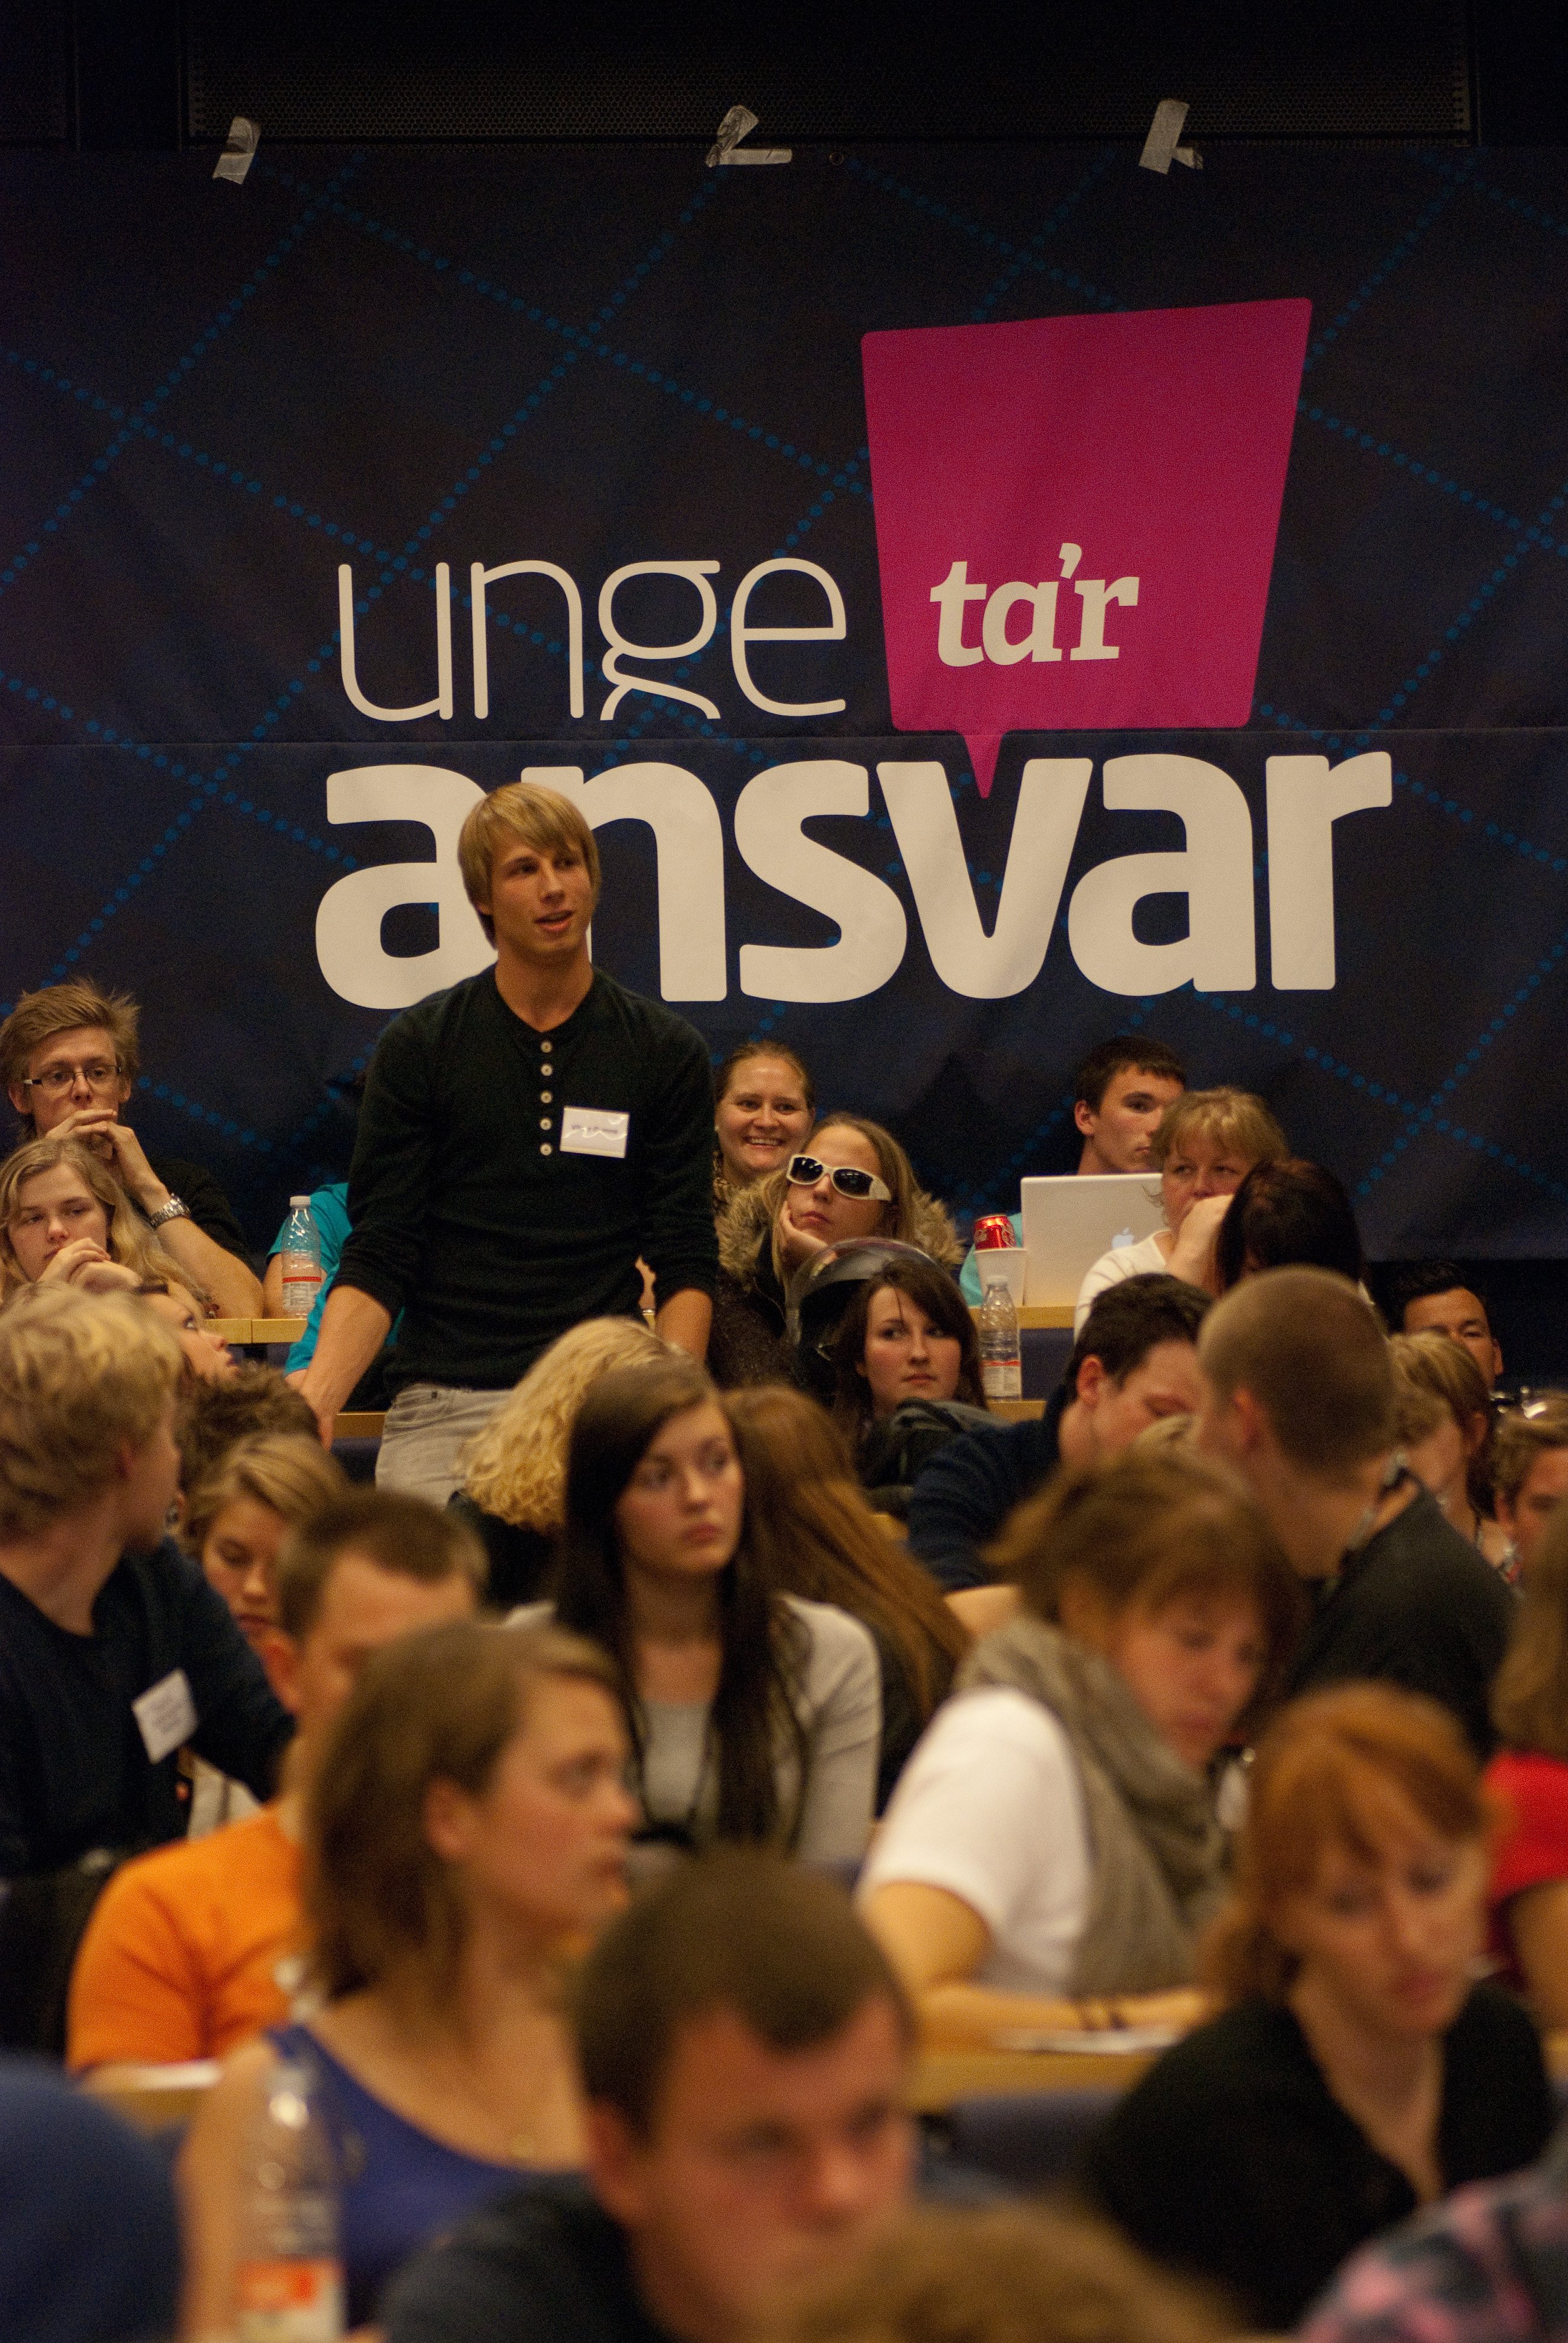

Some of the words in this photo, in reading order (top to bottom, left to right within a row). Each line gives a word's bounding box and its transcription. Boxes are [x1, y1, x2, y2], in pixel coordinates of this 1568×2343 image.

[338, 558, 846, 722] unge
[930, 543, 1140, 667] ta'r
[315, 751, 1393, 1010] ansvar
